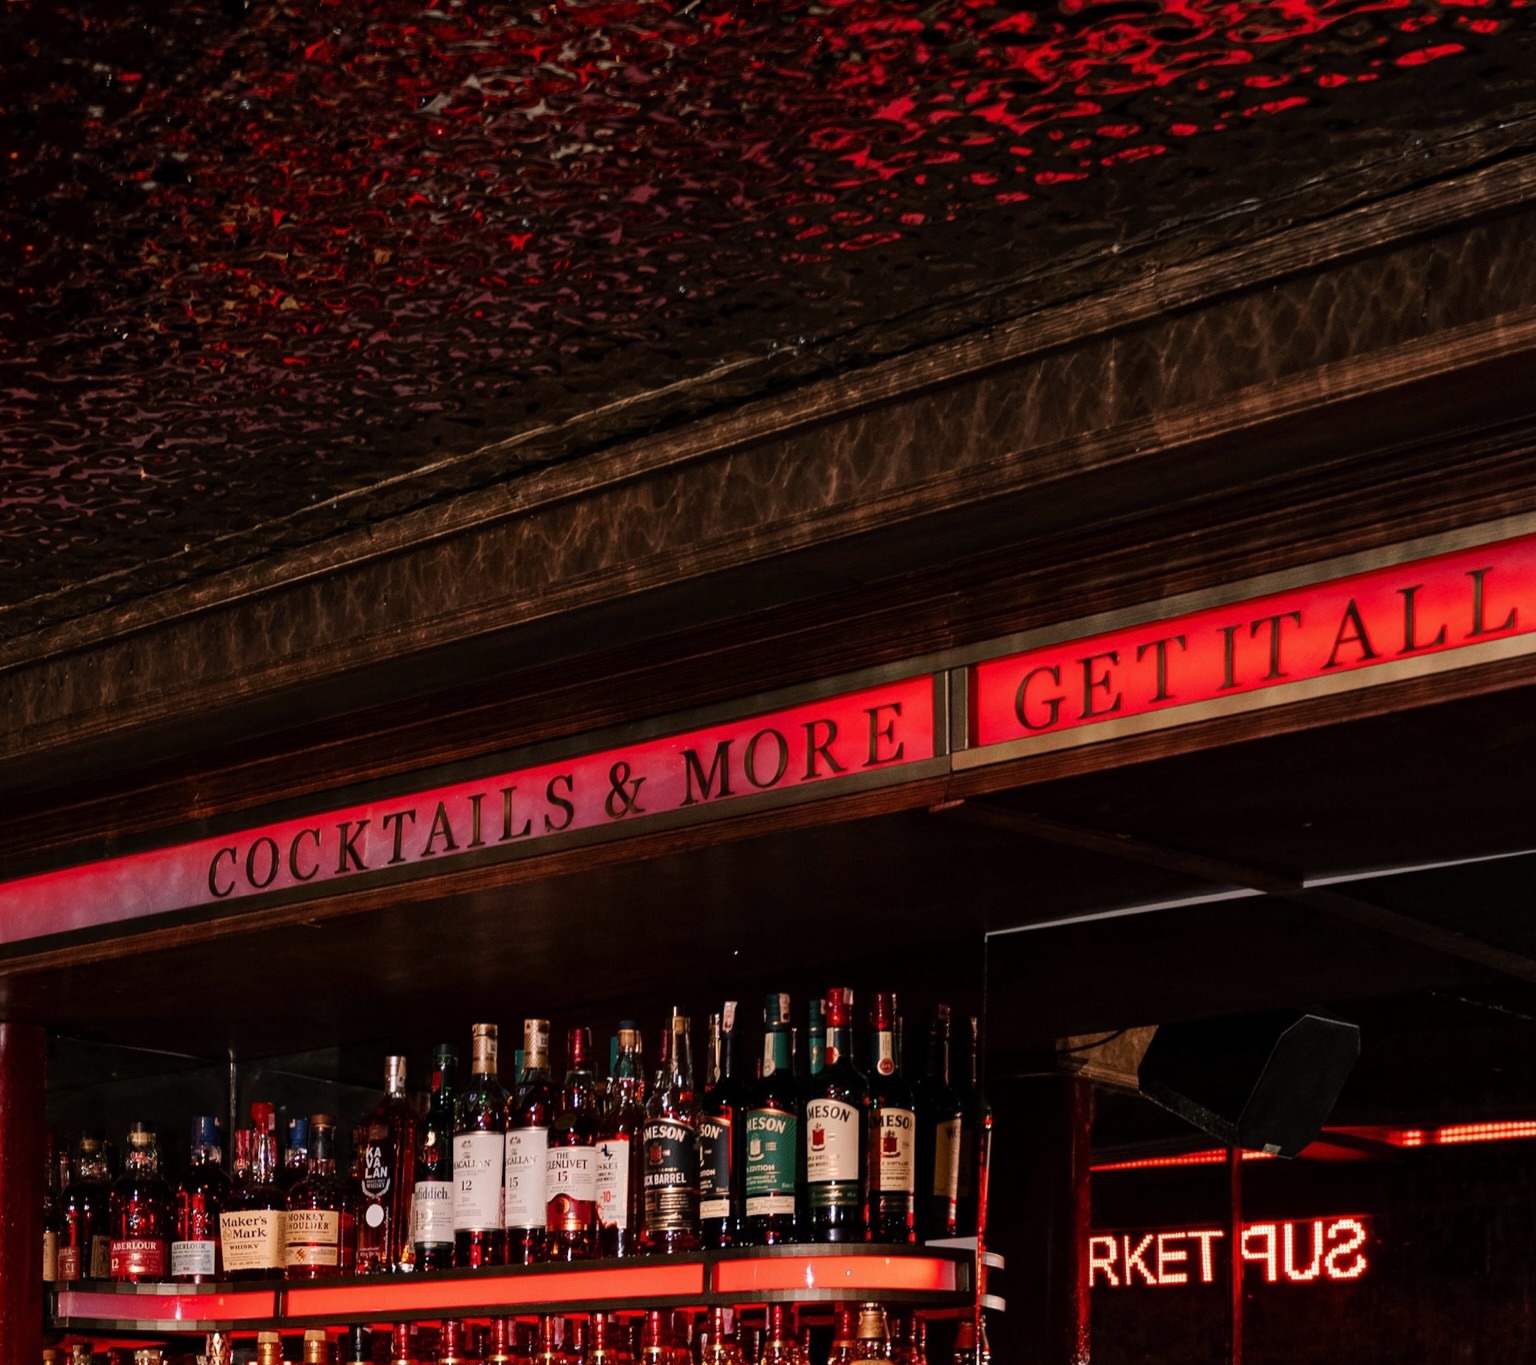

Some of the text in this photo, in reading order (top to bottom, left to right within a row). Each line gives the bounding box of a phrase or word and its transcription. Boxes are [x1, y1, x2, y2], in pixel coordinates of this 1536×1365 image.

[1014, 567, 1518, 730] GET IT ALL
[208, 702, 904, 898] COCKTAILS & MORE
[807, 1105, 852, 1123] MESON
[747, 1116, 786, 1134] MESON
[556, 1152, 569, 1160] THE
[508, 1177, 519, 1188] 15
[557, 1171, 568, 1182] 15
[654, 1172, 687, 1185] BARREL
[461, 1180, 472, 1191] 12
[221, 1215, 268, 1228] Maker's
[232, 1227, 267, 1239] Mark
[112, 1241, 157, 1251] ABERLOUR
